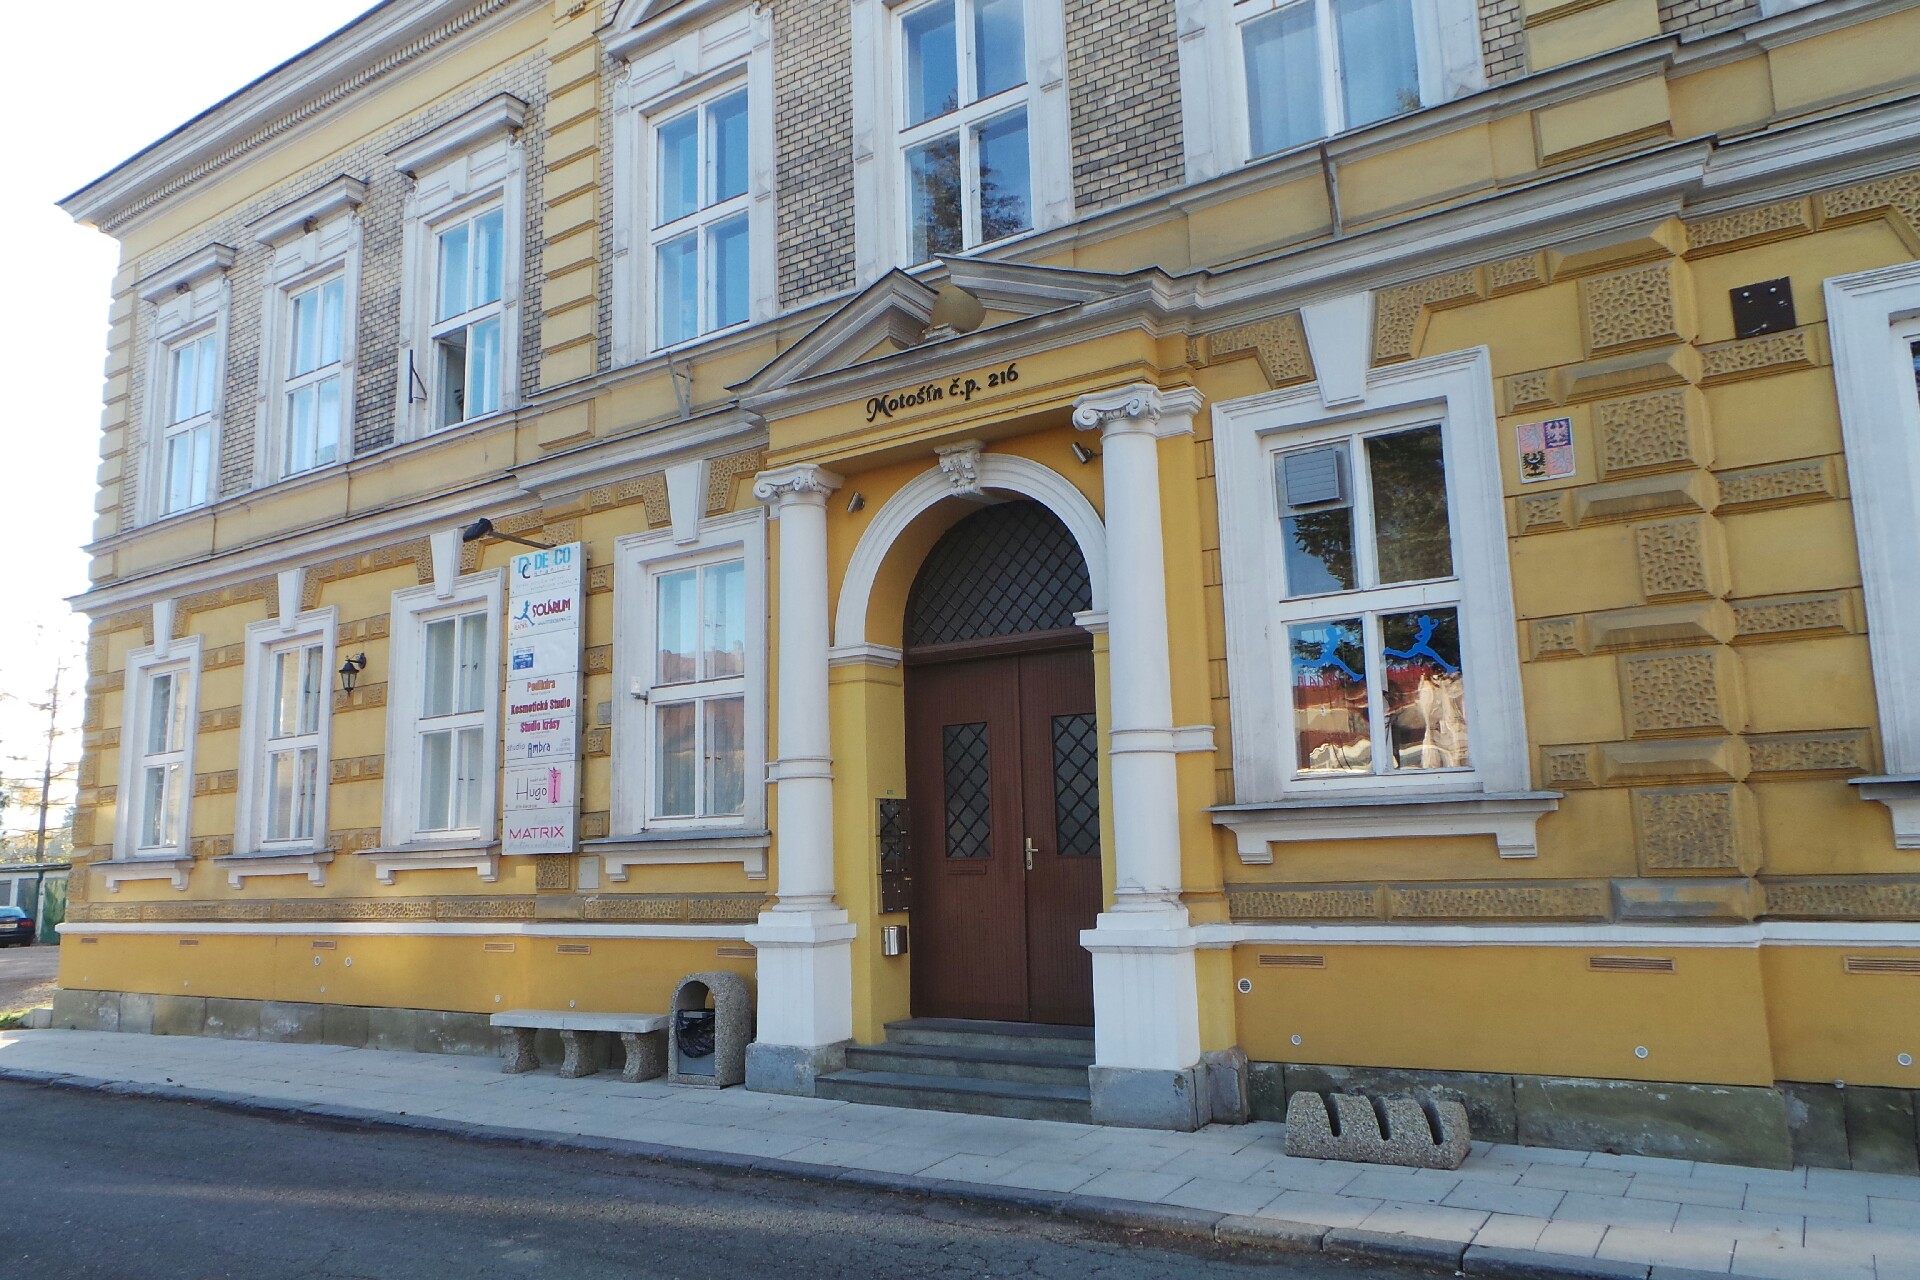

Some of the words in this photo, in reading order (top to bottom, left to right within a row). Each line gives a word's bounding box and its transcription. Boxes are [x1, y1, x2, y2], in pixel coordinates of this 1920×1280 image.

[866, 384, 944, 422] Motošín
[948, 377, 981, 401] č.p.
[988, 363, 1019, 387] 216
[554, 547, 571, 565] CO
[549, 697, 571, 710] Studio
[520, 720, 541, 733] Studio
[542, 718, 561, 731] krásy
[506, 742, 526, 752] studio
[527, 741, 551, 758] Ambra
[515, 777, 548, 801] Hugo
[508, 825, 565, 840] MATRIX
